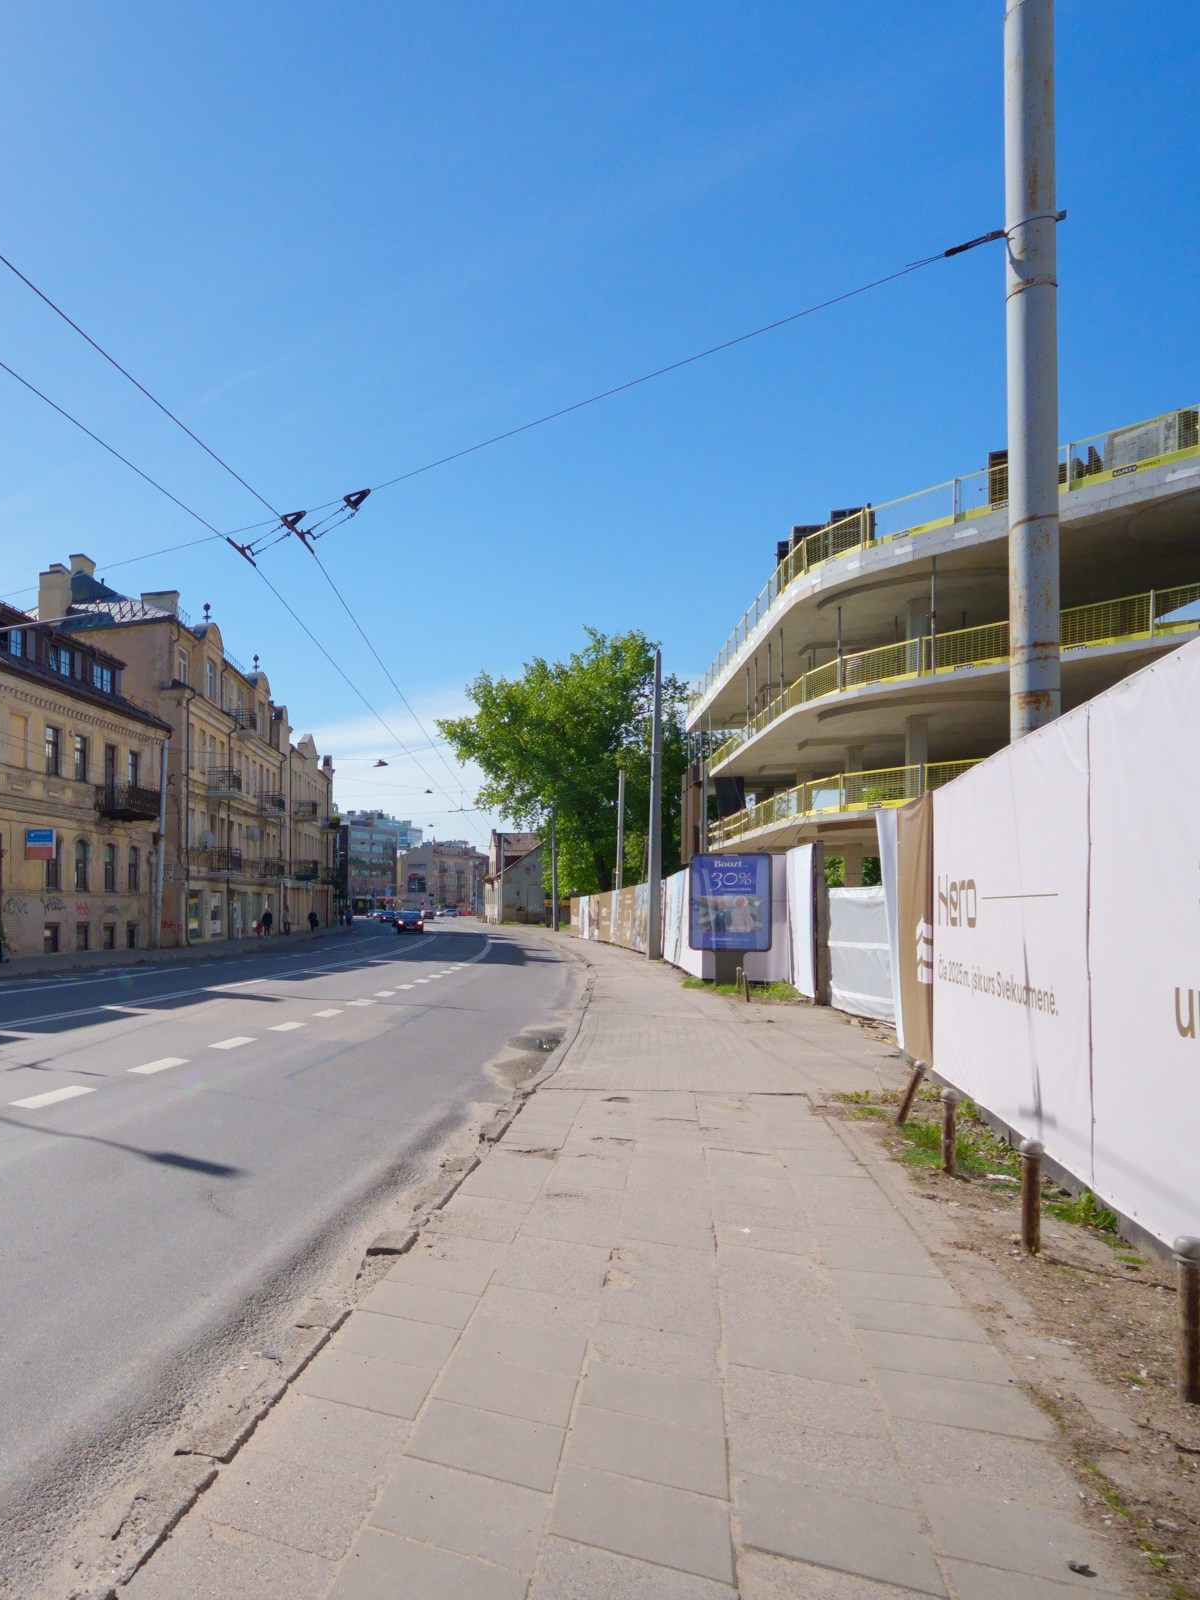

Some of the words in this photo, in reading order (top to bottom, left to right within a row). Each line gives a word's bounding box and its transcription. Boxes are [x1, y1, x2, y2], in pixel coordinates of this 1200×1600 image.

[1113, 464, 1137, 476] SAFETY
[714, 860, 742, 868] Boozt
[709, 872, 752, 891] 30%
[938, 874, 977, 928] Hero
[938, 953, 947, 980] Čia
[948, 960, 962, 986] 2025
[971, 965, 996, 996] įsikurs
[996, 971, 1059, 1017] Sveikuomenė.
